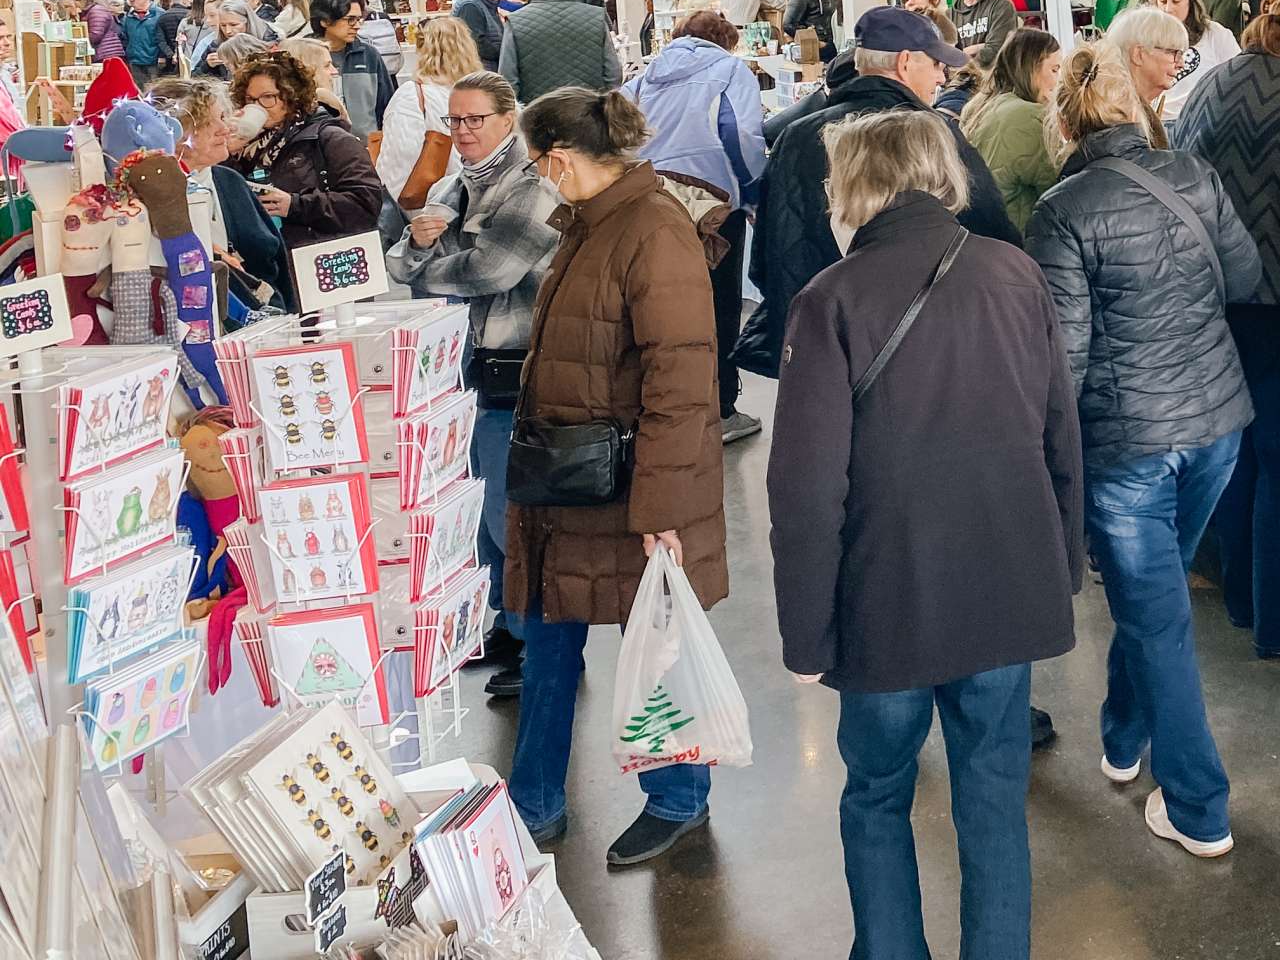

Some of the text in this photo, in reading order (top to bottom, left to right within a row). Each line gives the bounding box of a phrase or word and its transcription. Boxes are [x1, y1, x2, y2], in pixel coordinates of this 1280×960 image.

[322, 253, 359, 268] Greeting
[333, 263, 353, 274] Cards
[7, 298, 42, 313] Greeting
[286, 450, 310, 462] Bee
